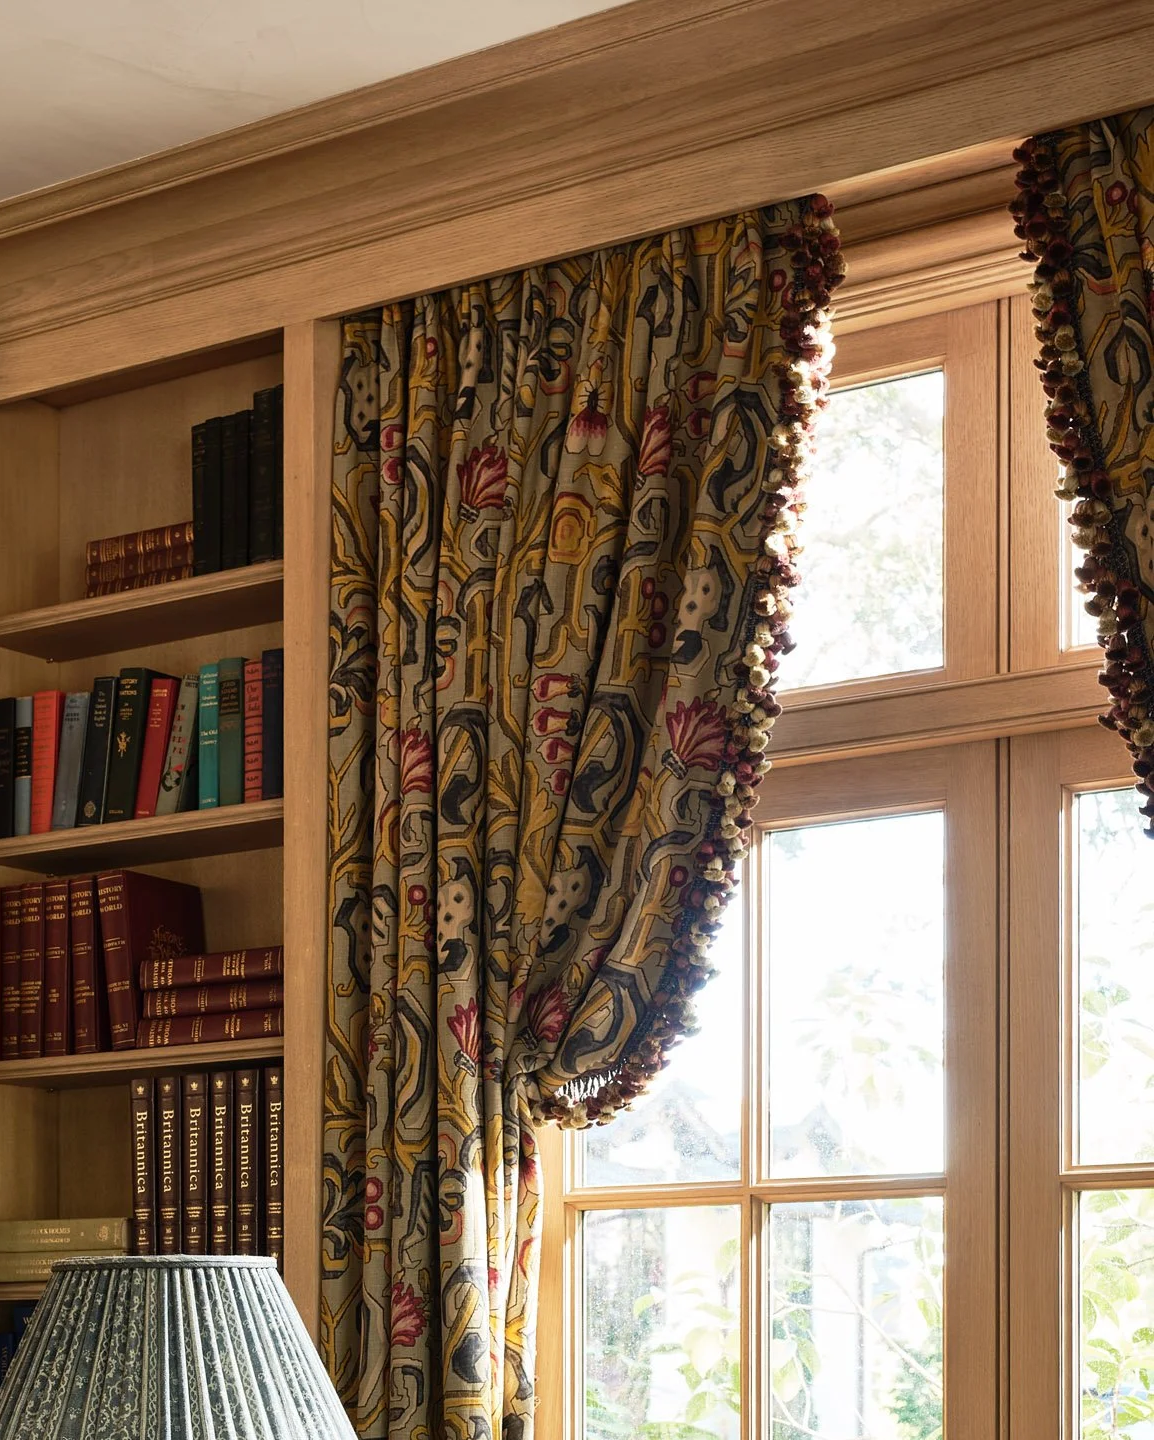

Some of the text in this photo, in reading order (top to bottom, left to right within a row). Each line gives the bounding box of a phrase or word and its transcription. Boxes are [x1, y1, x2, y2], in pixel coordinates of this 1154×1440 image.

[72, 891, 93, 899] ISTORY
[98, 885, 124, 896] HISTORY
[100, 904, 123, 912] WORLD
[136, 1111, 148, 1194] Britannica
[163, 1110, 174, 1193] Britannica
[189, 1107, 201, 1191] Britannica
[215, 1105, 226, 1190] Britannica
[241, 1103, 252, 1188] Britannica
[270, 1101, 282, 1187] Britannica
